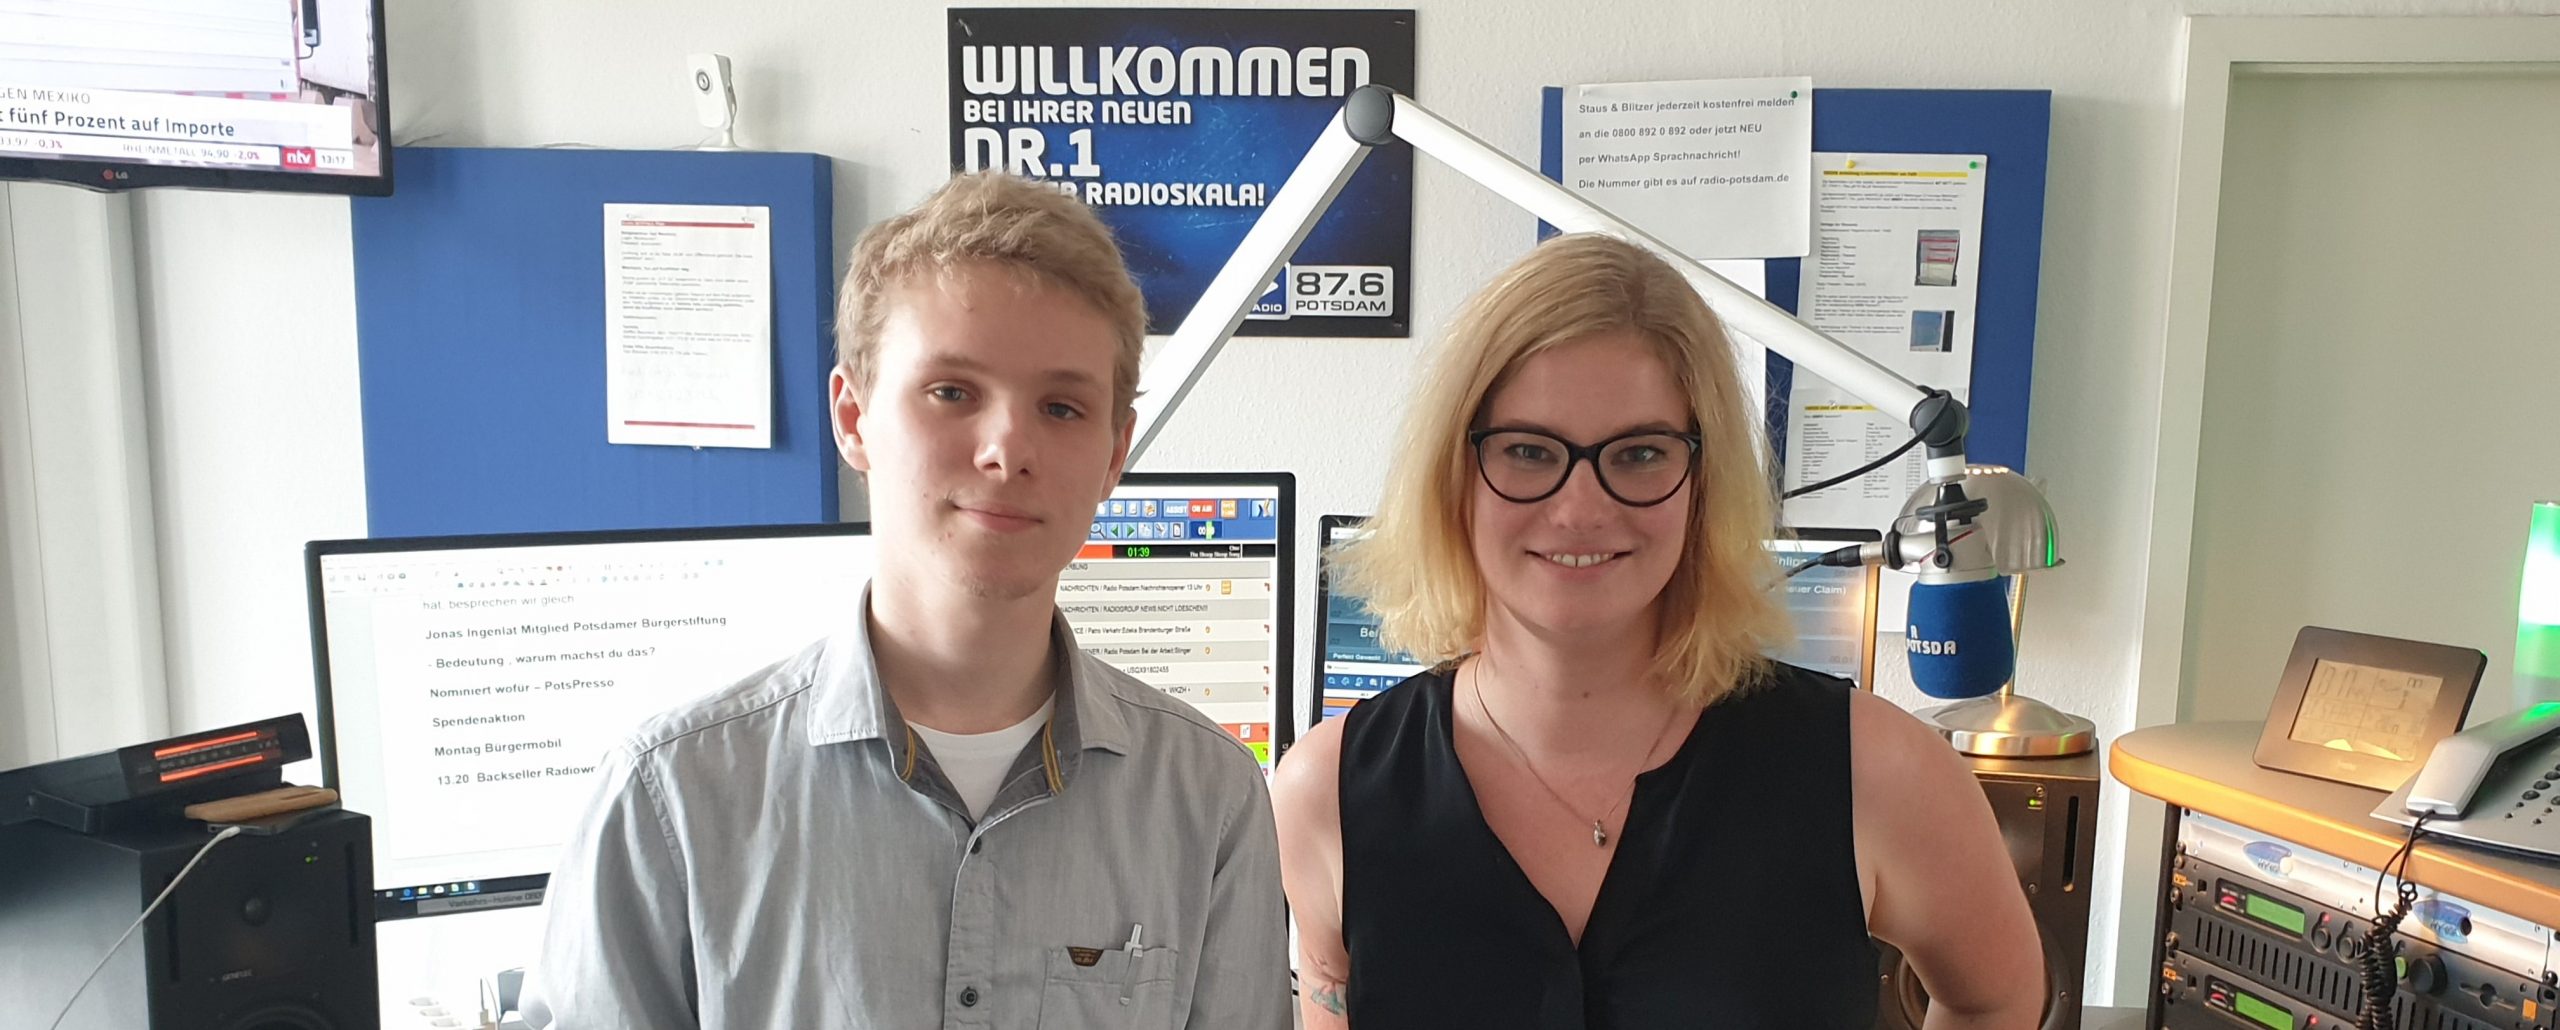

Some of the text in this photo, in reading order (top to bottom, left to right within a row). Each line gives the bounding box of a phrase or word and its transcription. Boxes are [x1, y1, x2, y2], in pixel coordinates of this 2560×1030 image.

[962, 45, 1370, 97] WILLKOMMEN
[33, 90, 91, 104] MEXIKO
[963, 100, 1191, 124] BEI IHRER NEUEN
[1579, 98, 1795, 113] Staus & Blitzer jederzeit kostenfrei melden
[10, 108, 48, 125] fünf
[55, 111, 126, 131] Prozent
[132, 118, 160, 132] auf
[166, 118, 235, 137] Importe
[1594, 129, 1610, 138] die
[1612, 128, 1636, 138] 0800
[1638, 127, 1656, 136] 892
[1659, 127, 1666, 136] 0
[1668, 126, 1686, 136] 892
[1689, 126, 1712, 135] oder
[1714, 125, 1737, 136] jetzt
[1740, 124, 1762, 133] NEU
[963, 127, 1101, 178] NR.1
[1578, 150, 1741, 164] per WhatsApp Sprachnachricht!
[1579, 173, 1789, 189] Die Nummer gibt es auf radio-potsdam.de
[1085, 182, 1264, 207] RADIOSKALA!
[1295, 272, 1386, 297] 87.6
[1251, 303, 1283, 312] ADIO
[1295, 300, 1387, 313] POTSDAM
[1127, 547, 1150, 557] 01:39
[1813, 585, 1847, 596] Claim)
[449, 595, 517, 611] besprechen
[521, 596, 536, 606] wir
[541, 593, 575, 608] gleich
[426, 629, 464, 640] Jonas
[521, 622, 570, 636] Mitglied
[573, 620, 638, 632] Potsdamer
[1910, 624, 1918, 640] R
[436, 654, 504, 670] Bedeutung
[515, 652, 557, 664] warum
[560, 649, 605, 661] machst
[608, 648, 623, 658] du
[627, 646, 656, 658] das?
[430, 685, 492, 698] Nominiert
[544, 678, 615, 692] PotsPresso
[432, 712, 526, 729] Spendenaktion
[434, 744, 481, 758] Montag
[477, 768, 542, 783] Backseller
